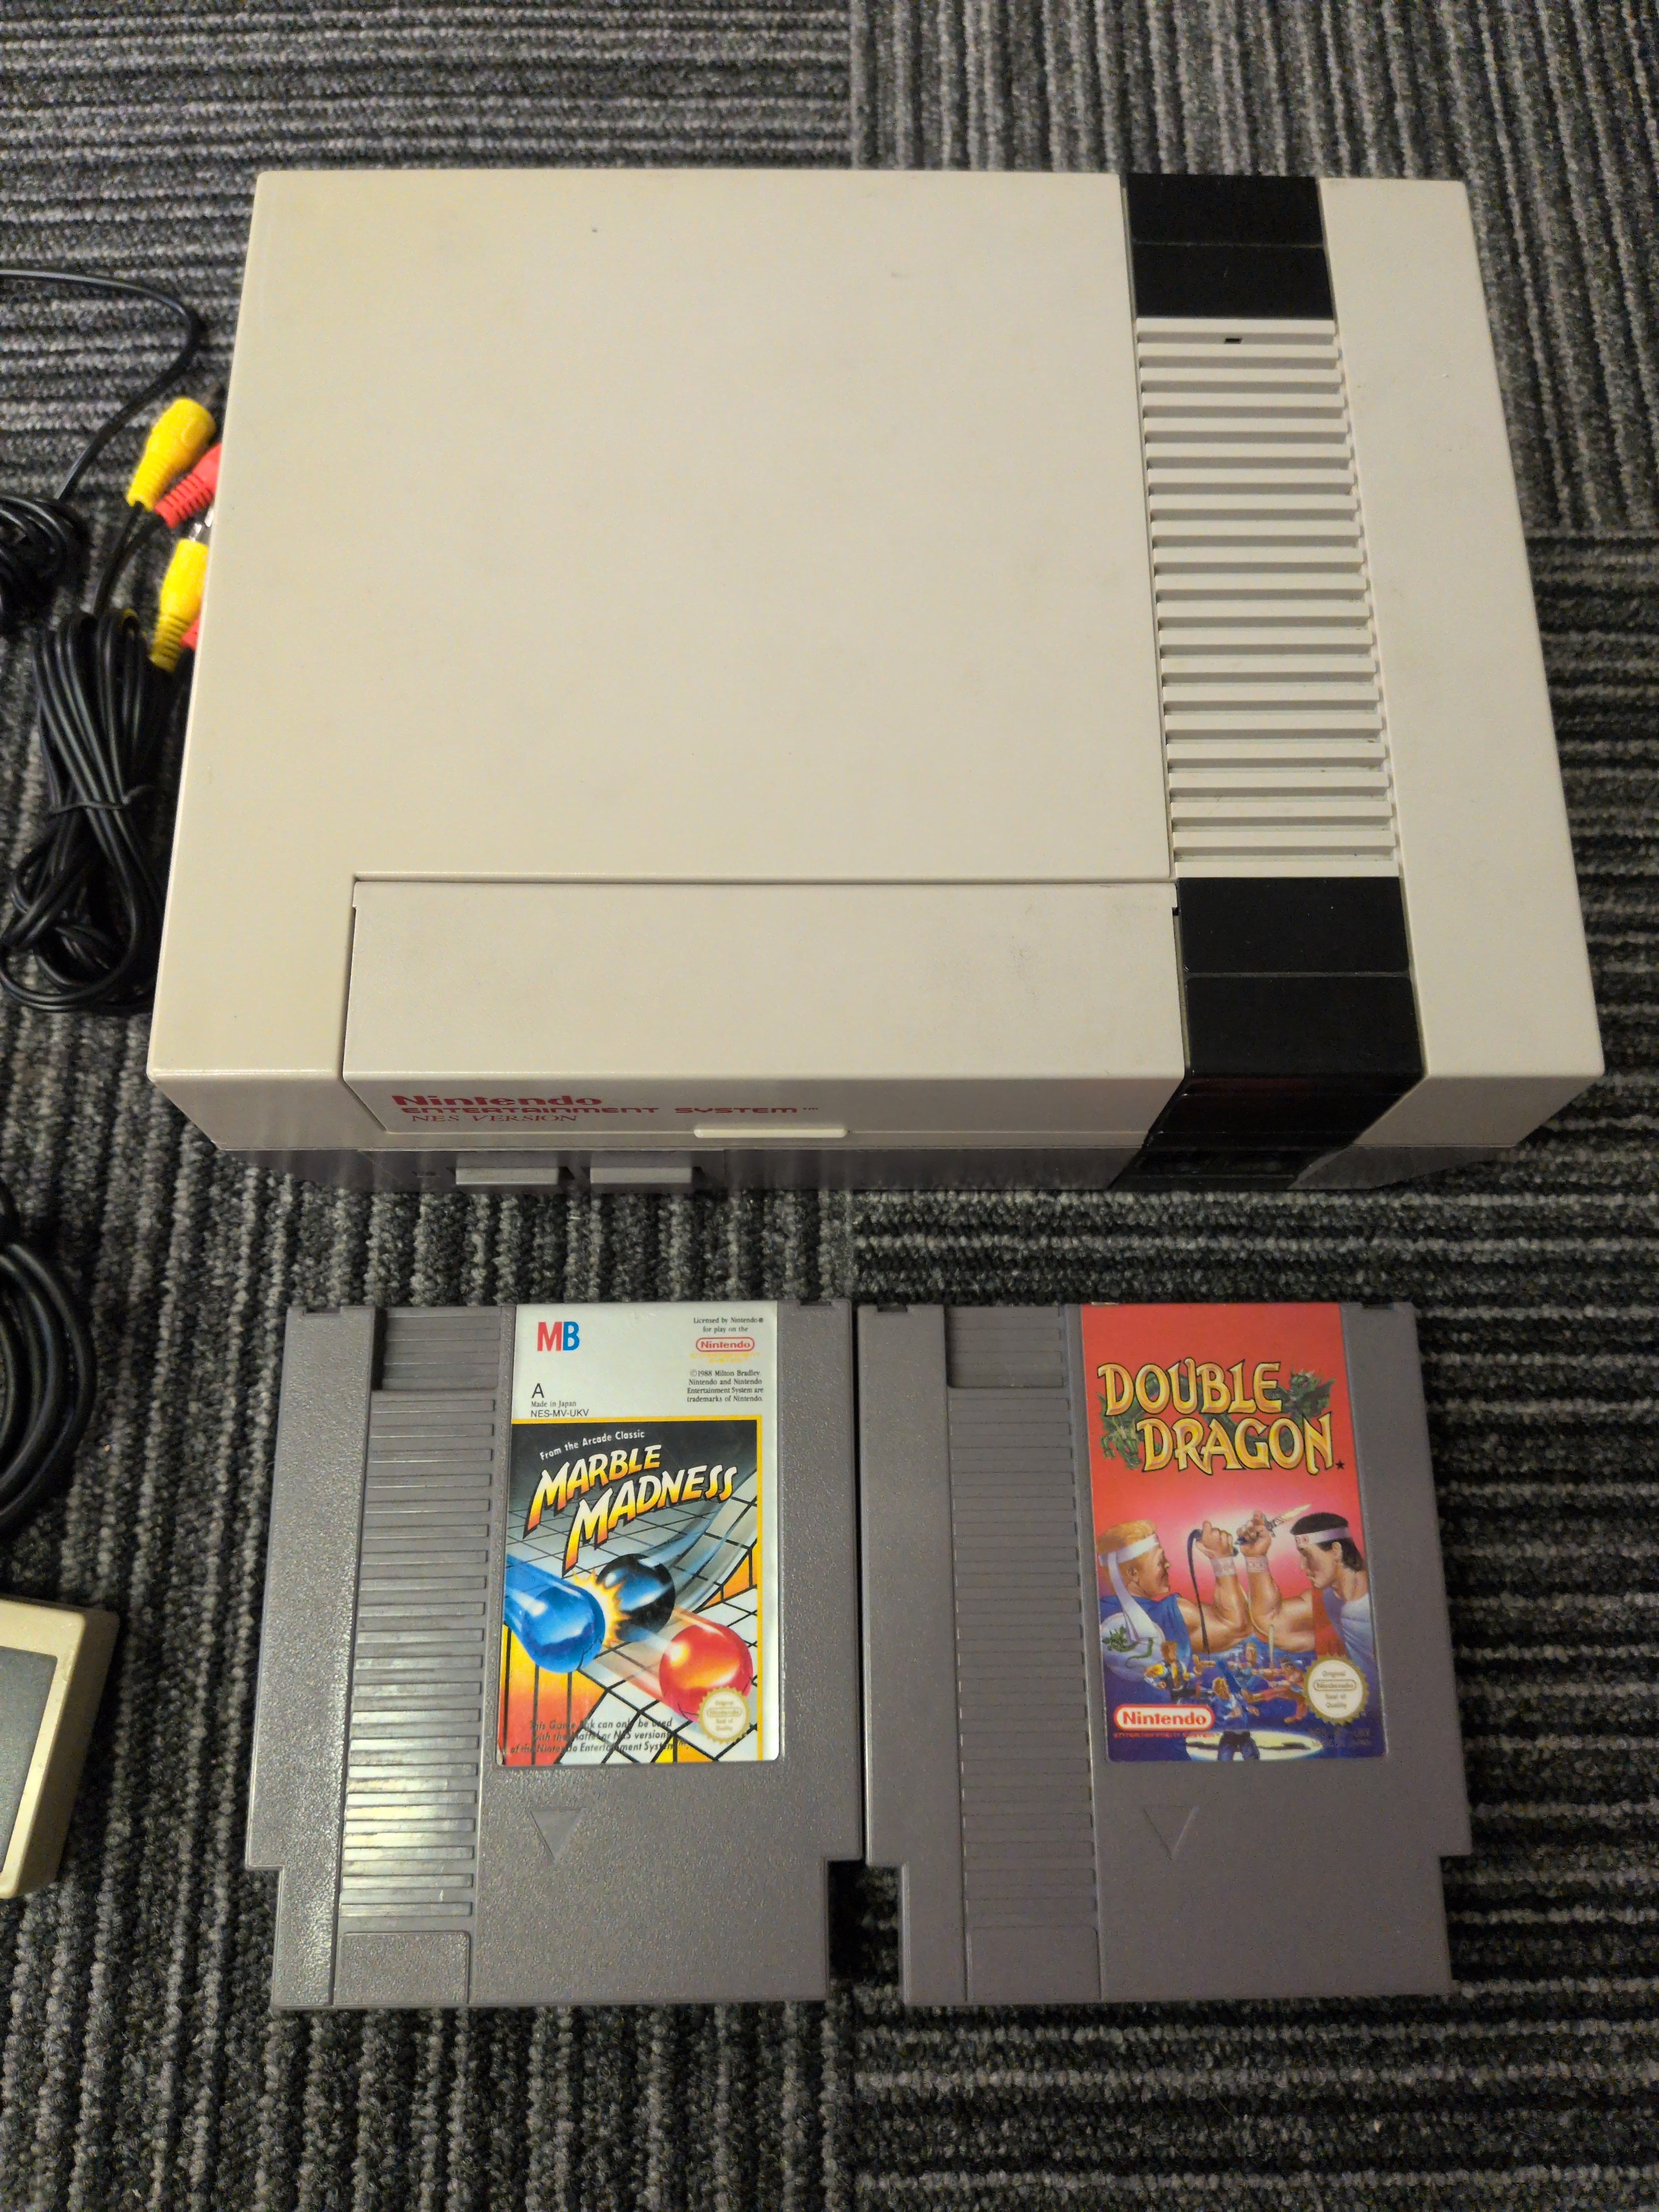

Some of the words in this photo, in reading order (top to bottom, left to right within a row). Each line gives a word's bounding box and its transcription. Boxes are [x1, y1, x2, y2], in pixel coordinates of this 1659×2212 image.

[392, 1095, 602, 1105] Nintendo
[538, 1321, 580, 1352] MB
[701, 1340, 751, 1349] Nintendo
[531, 1383, 545, 1398] A
[1097, 1357, 1283, 1416] DOUBLE
[559, 1400, 577, 1408] Japan
[531, 1408, 589, 1417] NES-MV-UKV
[539, 1447, 562, 1460] From
[564, 1441, 579, 1451] the
[582, 1433, 612, 1447] Arcade
[615, 1430, 645, 1440] Classic
[1136, 1412, 1334, 1475] DRAGON
[524, 1444, 662, 1537] MARBLE
[563, 1464, 738, 1577] MADNESS
[638, 1718, 649, 1728] be
[1123, 1711, 1207, 1725] Nintendo
